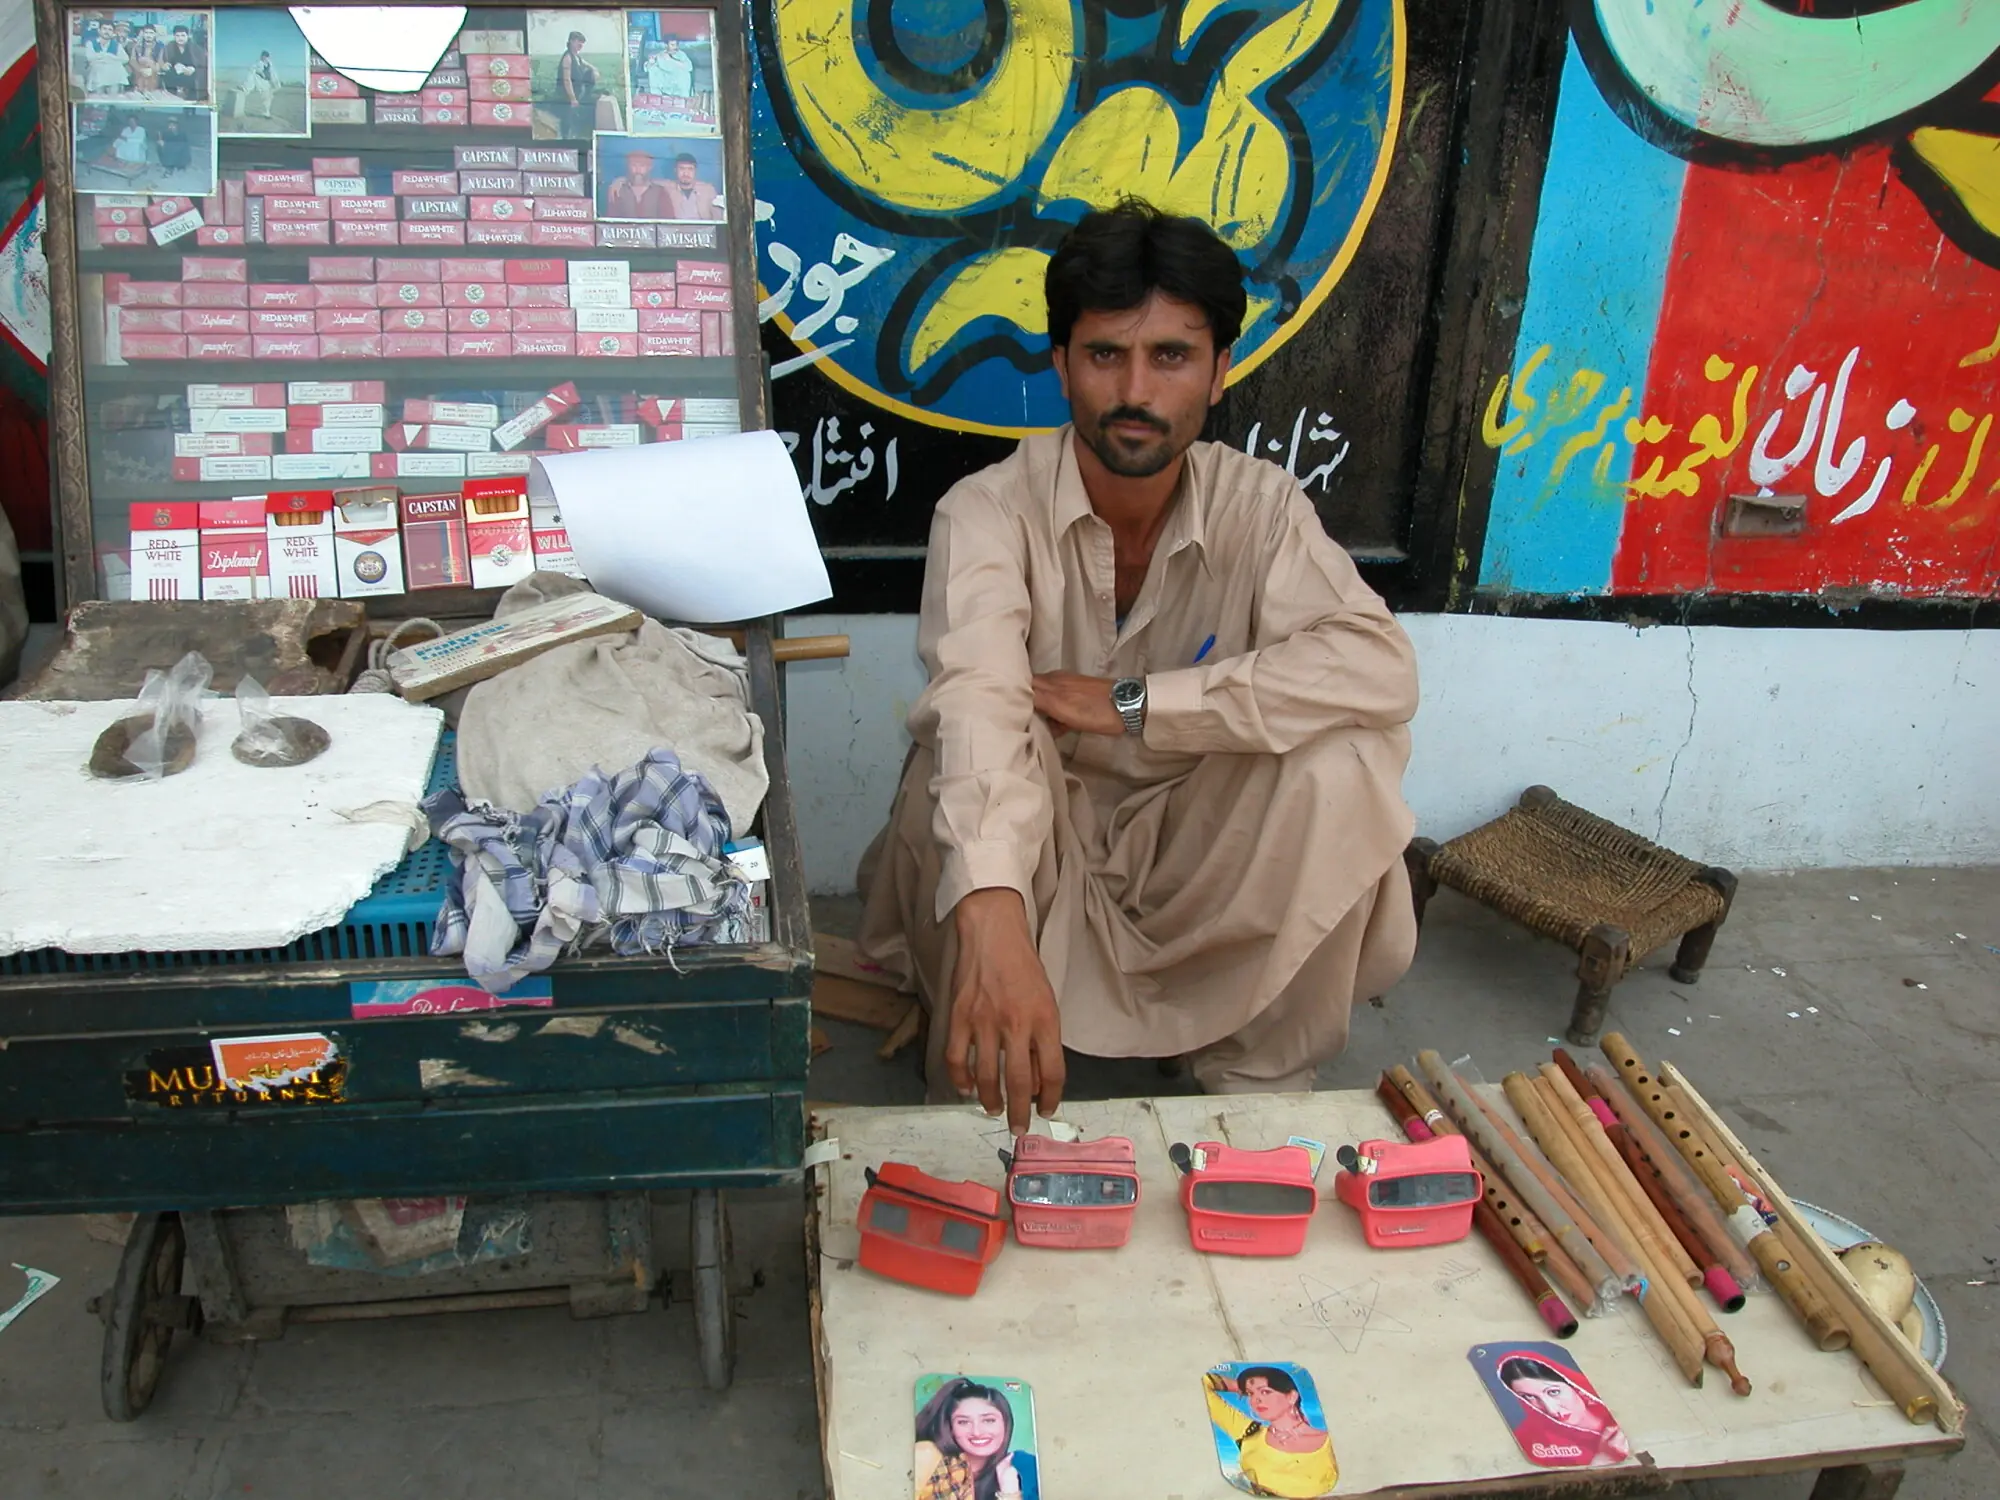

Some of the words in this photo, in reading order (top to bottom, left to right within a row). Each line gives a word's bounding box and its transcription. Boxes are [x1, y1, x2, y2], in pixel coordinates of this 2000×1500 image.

[462, 151, 508, 163] CAPSTAN
[524, 152, 570, 164] CAPSTAN
[259, 174, 305, 183] RED&WHITE
[402, 175, 449, 183] RED&WHITE
[468, 177, 515, 189] CAPSTAN
[530, 176, 577, 188] CAPSTAN
[341, 200, 387, 208] RED&WHITE
[411, 201, 459, 213] CAPSTAN
[409, 225, 456, 233] RED&WHITE
[602, 227, 648, 239] CAPSTAN
[665, 233, 713, 246] CAPSTAN
[261, 314, 308, 323] RED&WHITE
[332, 312, 368, 326] Diplomat
[647, 337, 692, 345] RED&WHITE
[408, 499, 457, 514] CAPSTAN
[286, 537, 314, 547] RED&
[146, 551, 182, 561] WHITE
[283, 547, 319, 558] WHITE
[207, 549, 262, 573] Diplomat
[1532, 1443, 1582, 1459] Saima
